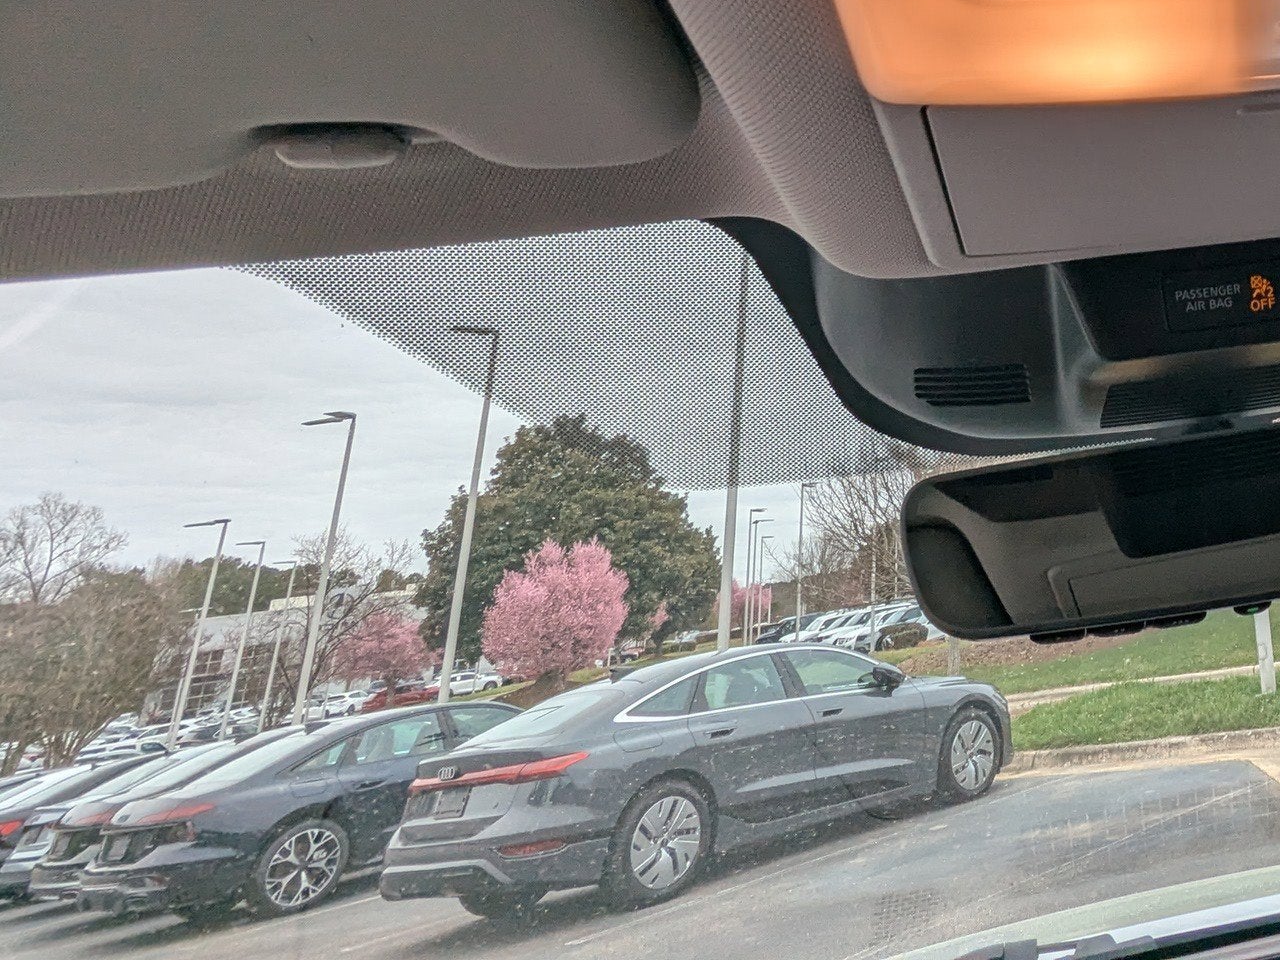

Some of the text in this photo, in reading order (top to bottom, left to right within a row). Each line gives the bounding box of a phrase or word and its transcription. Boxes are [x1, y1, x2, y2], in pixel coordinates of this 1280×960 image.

[1174, 283, 1241, 302] PASSENGER
[1185, 296, 1234, 313] AIR BAG
[1250, 297, 1276, 312] OFF
